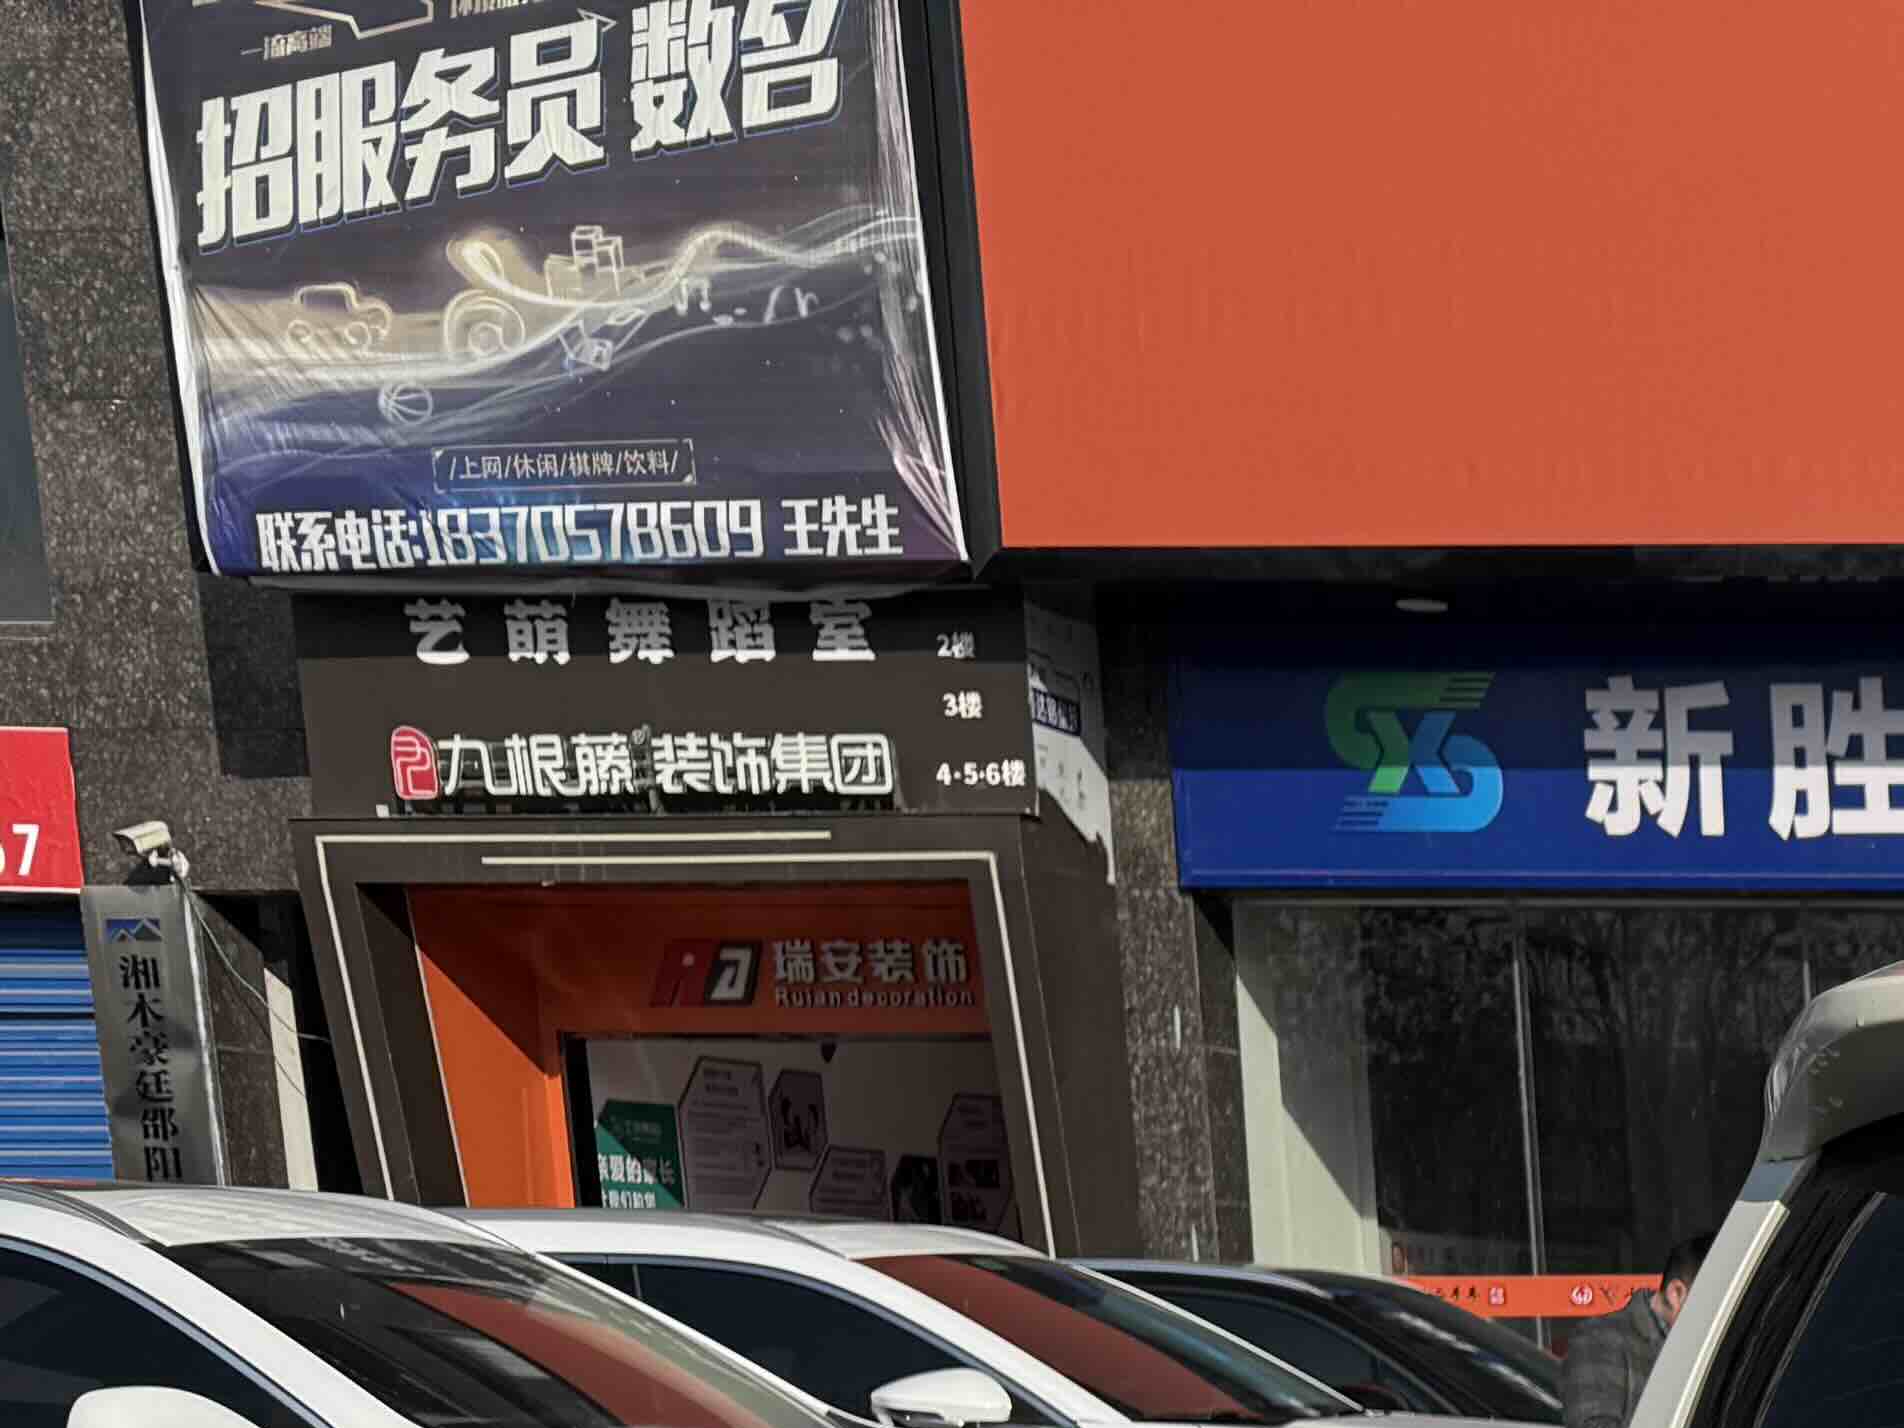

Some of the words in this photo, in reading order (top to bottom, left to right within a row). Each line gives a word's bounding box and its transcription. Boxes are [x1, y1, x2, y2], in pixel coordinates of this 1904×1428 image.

[197, 18, 607, 248] 招服务员
[630, 0, 839, 152] 数名
[256, 499, 764, 571] 联系电话:18370578609
[782, 494, 903, 558] 王先生
[404, 599, 877, 664] 艺萌舞蹈室
[943, 690, 983, 719] 3楼
[772, 939, 969, 985] 瑞安装饰
